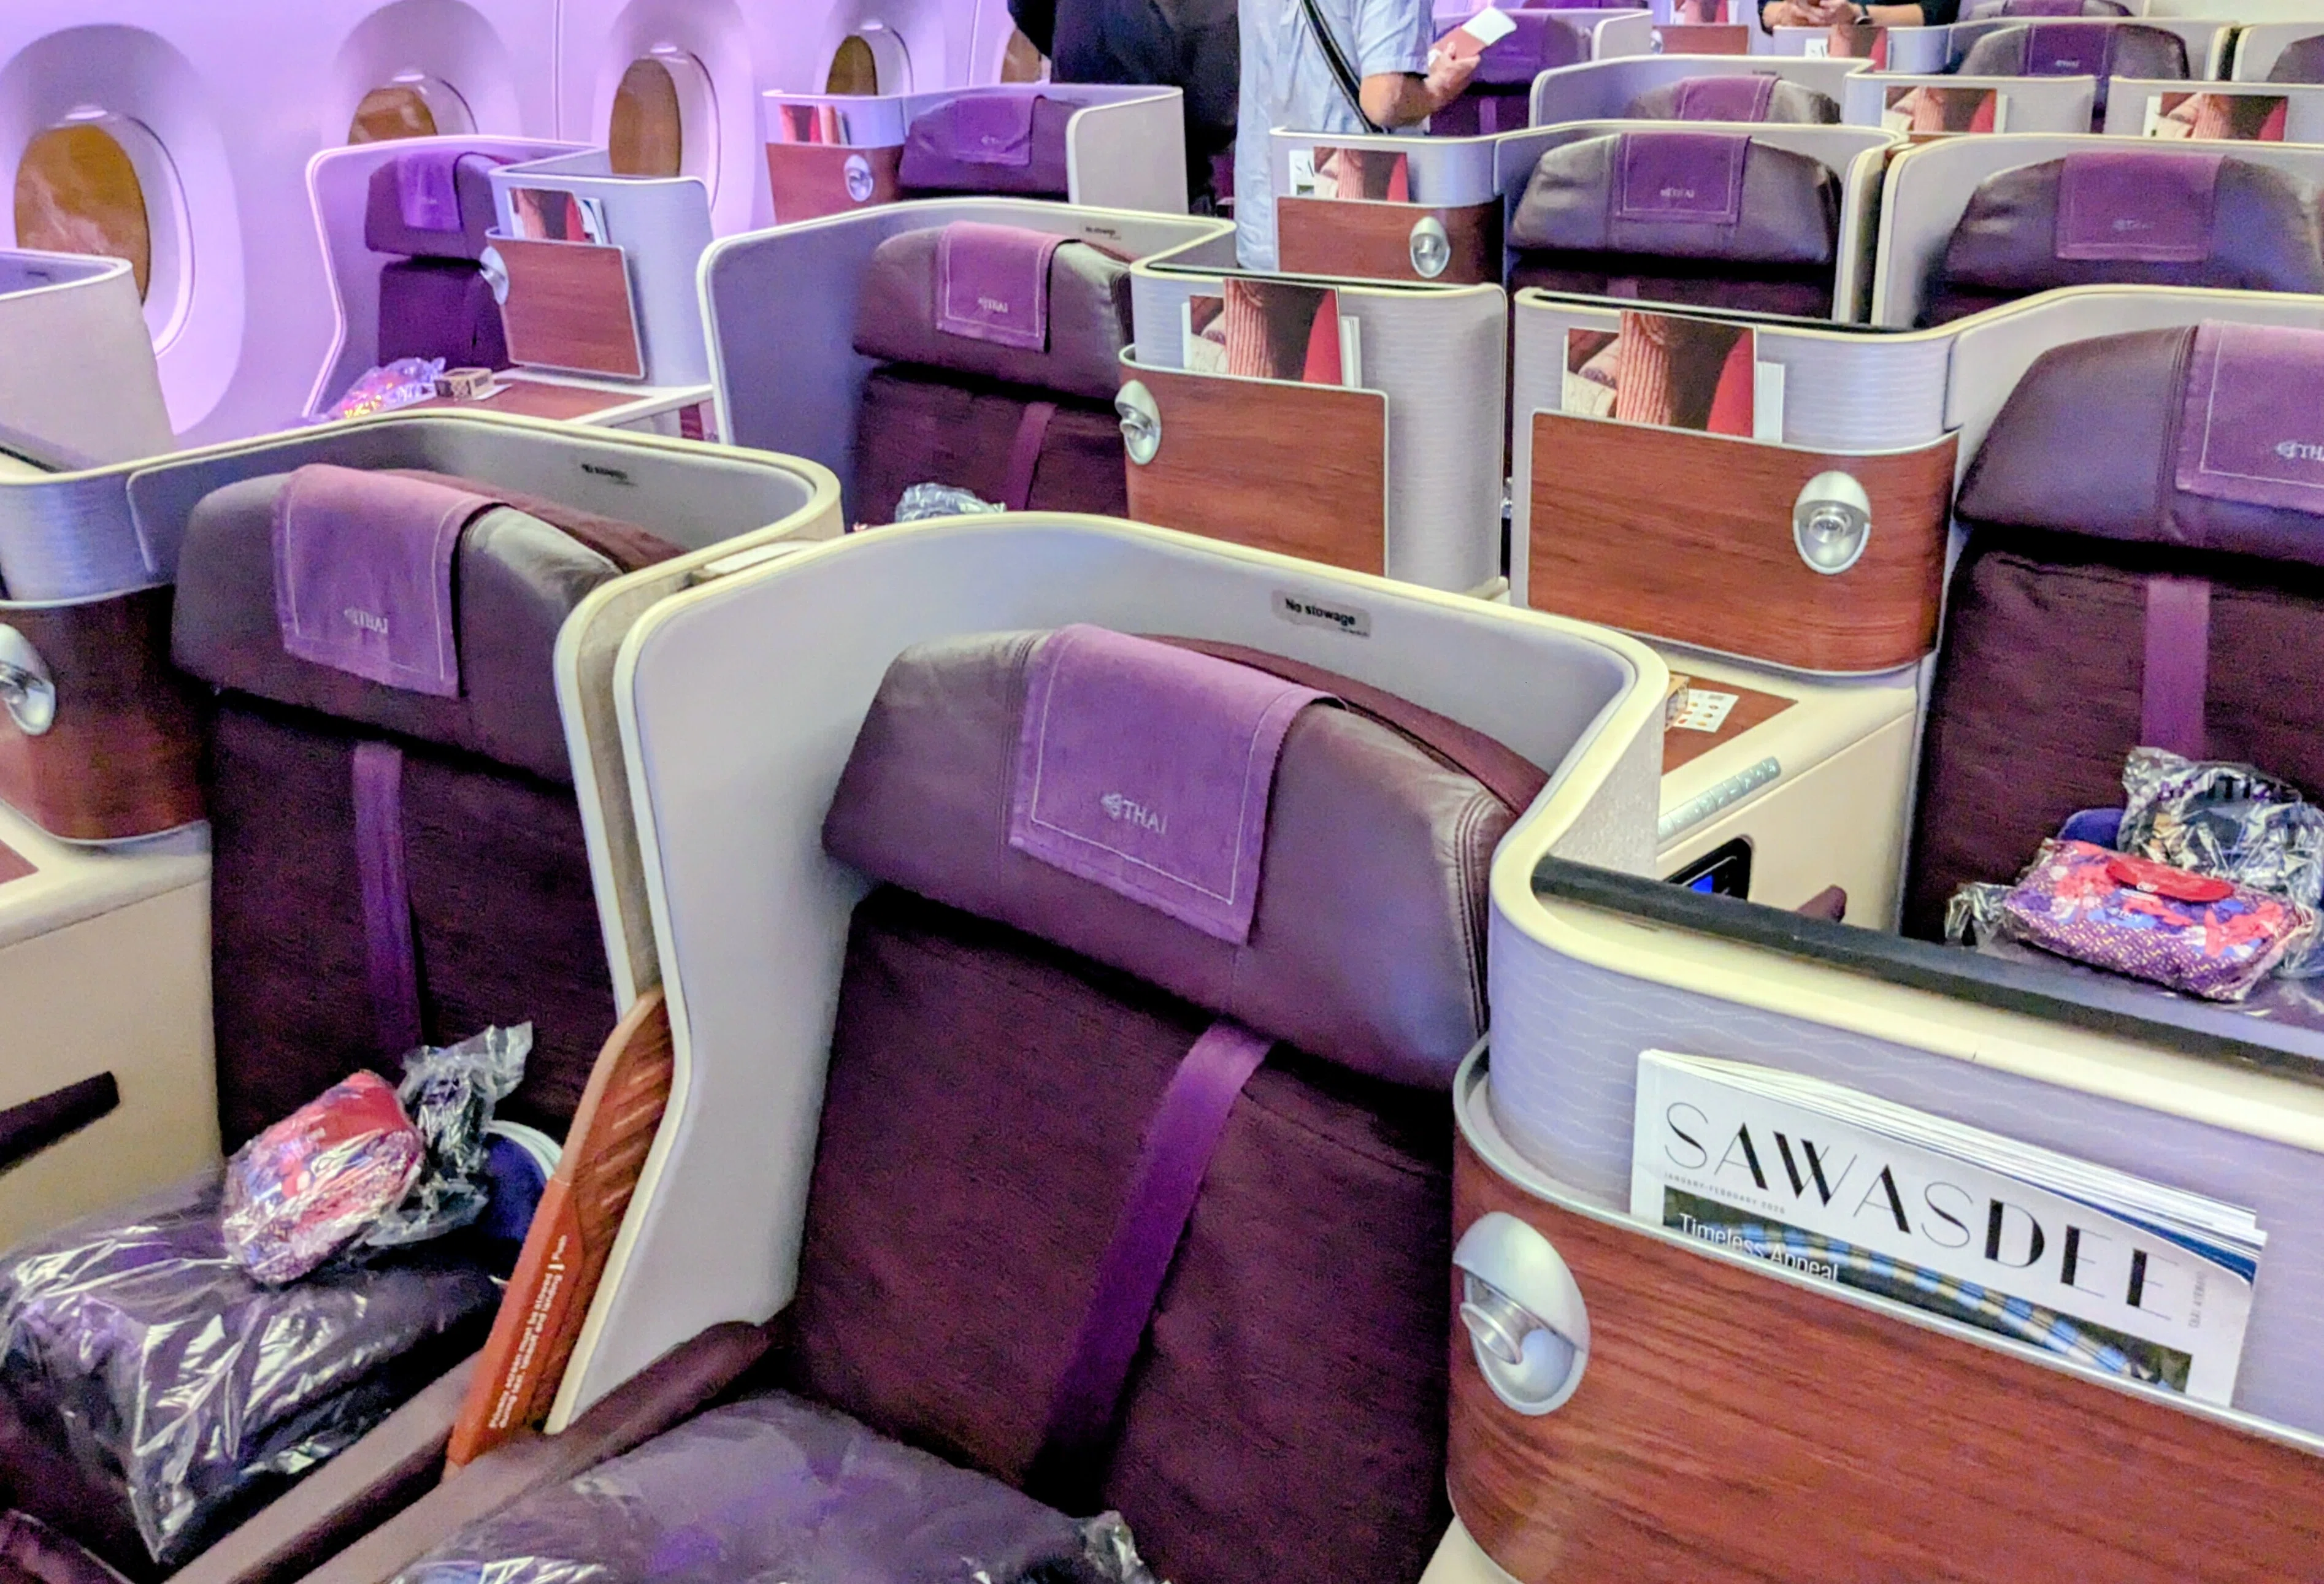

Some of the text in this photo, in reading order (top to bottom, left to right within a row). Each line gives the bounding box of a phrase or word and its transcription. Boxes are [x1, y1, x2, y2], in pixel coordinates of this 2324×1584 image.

[1286, 597, 1356, 627] No stowage
[1122, 799, 1168, 835] THAI
[1664, 1101, 2179, 1322] SAWASDEE
[1679, 1212, 1765, 1258] Timeless
